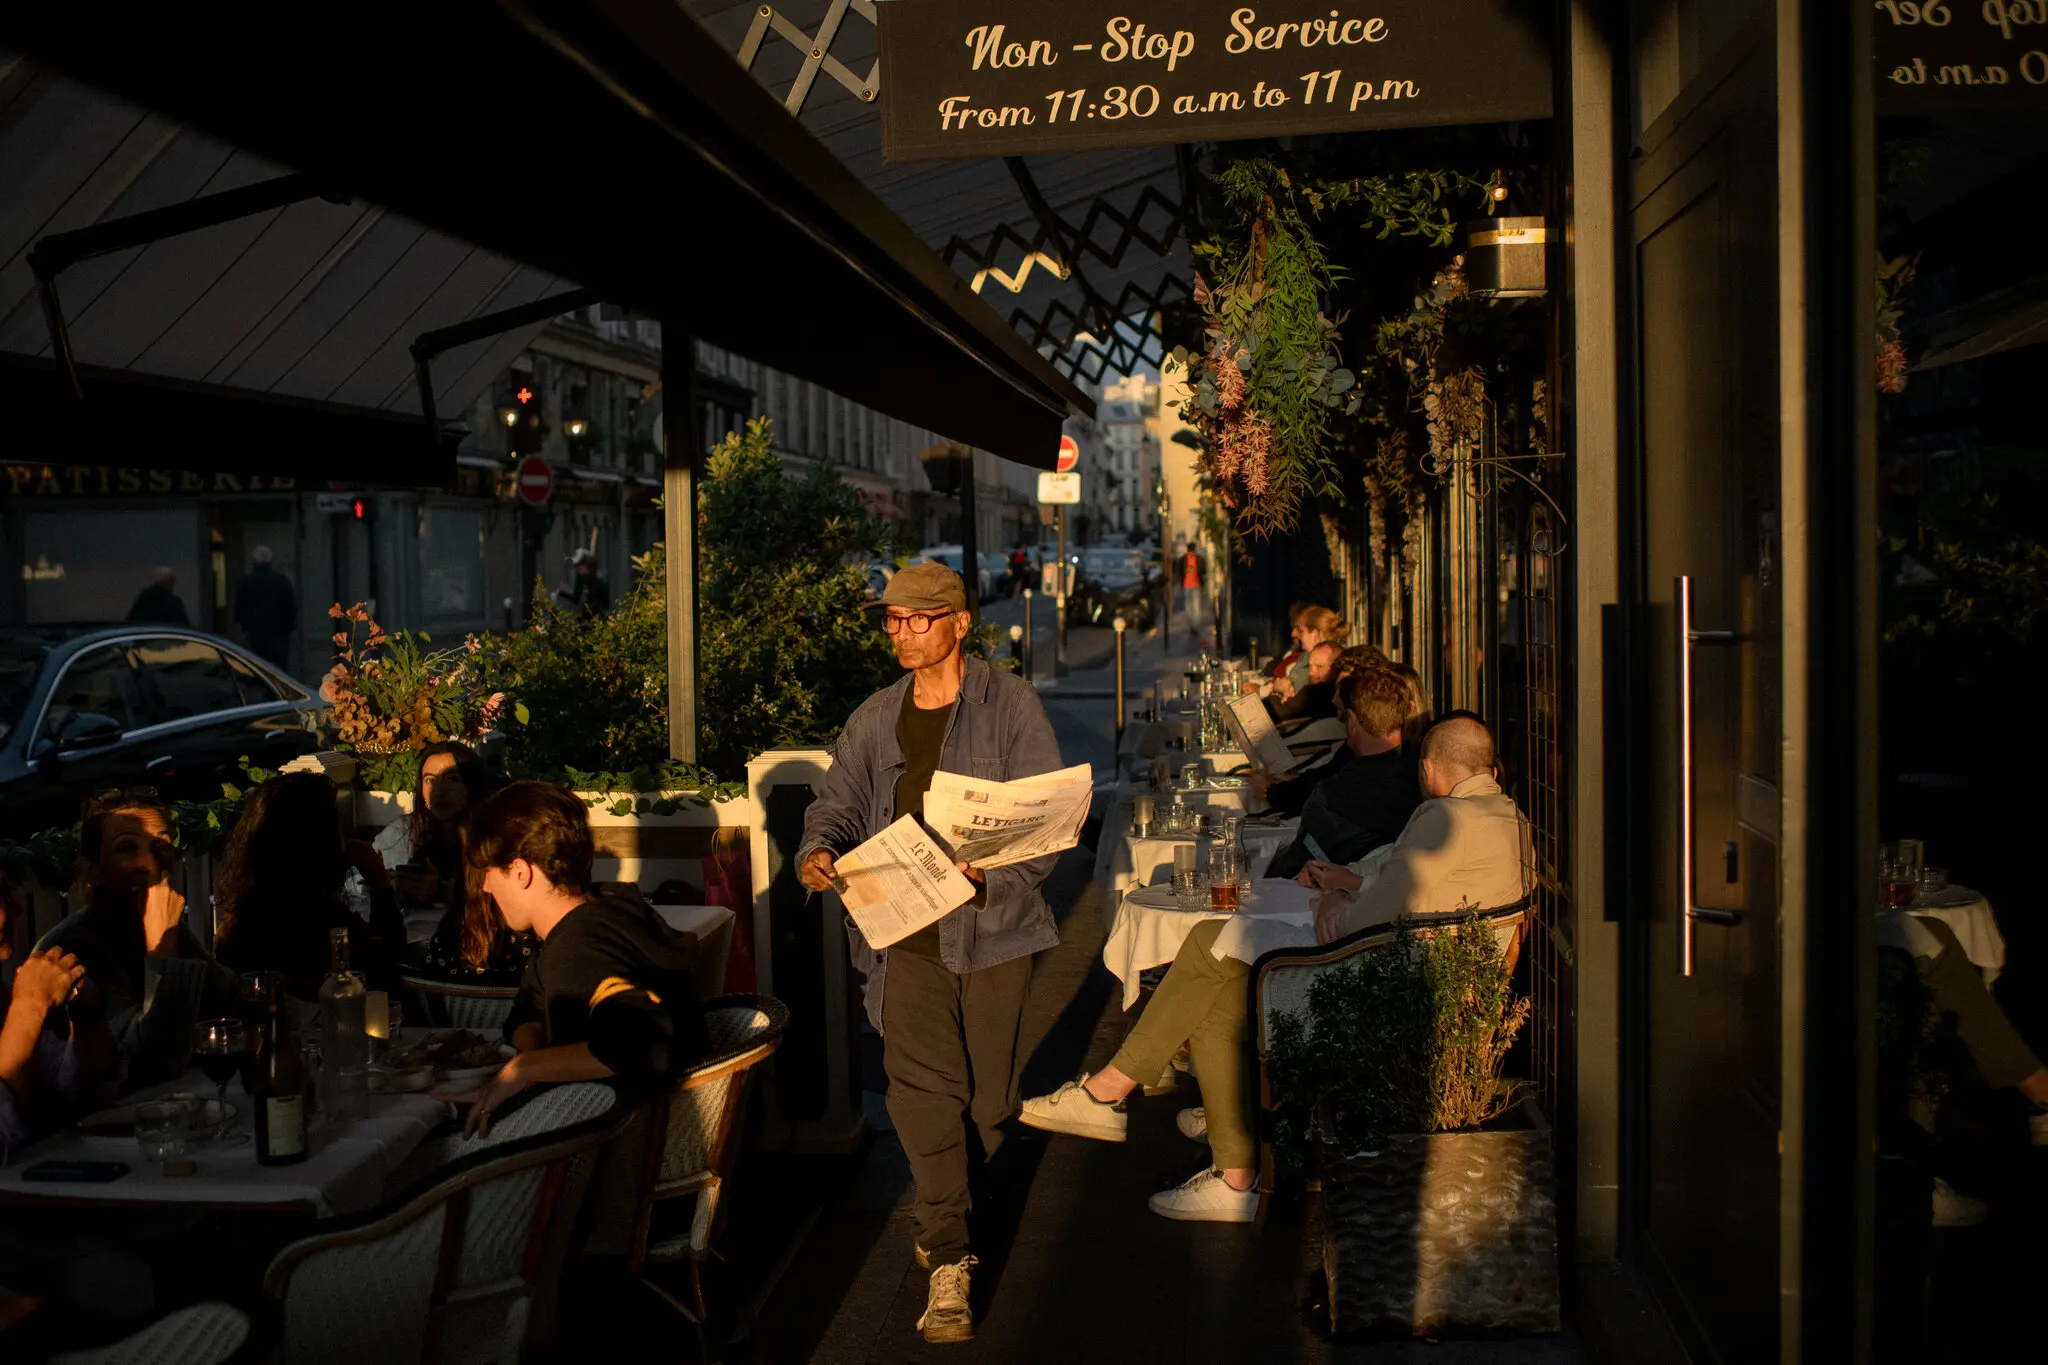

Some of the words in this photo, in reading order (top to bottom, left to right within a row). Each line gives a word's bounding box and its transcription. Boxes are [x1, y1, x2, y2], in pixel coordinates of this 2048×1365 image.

[964, 24, 1059, 71] Non
[1224, 7, 1389, 54] Service
[937, 95, 1036, 131] From
[1044, 84, 1160, 124] 11:30
[1172, 91, 1246, 115] a.m
[1252, 81, 1291, 108] to
[1299, 69, 1342, 105] 11
[1349, 79, 1421, 112] p.m
[970, 814, 992, 827] LE
[910, 842, 925, 856] Le
[919, 850, 947, 883] Monde
